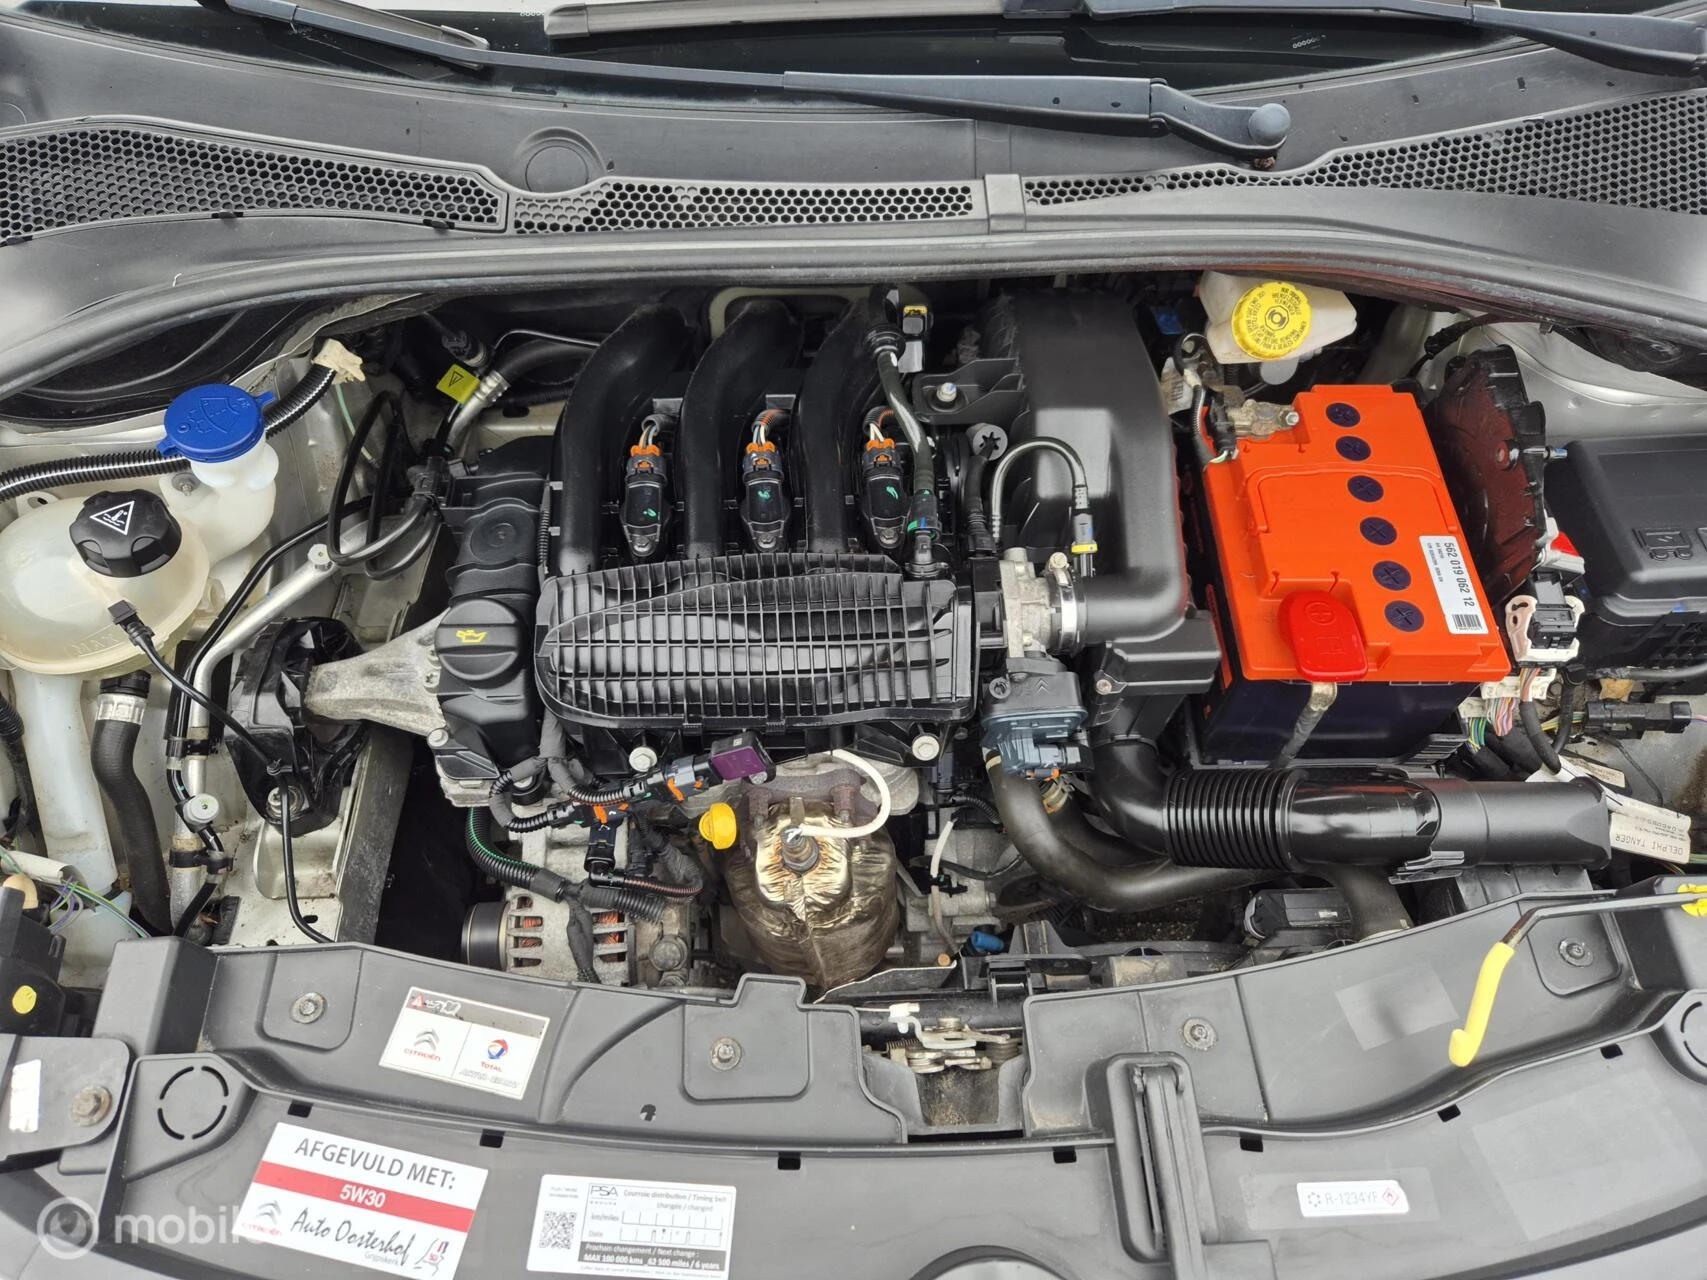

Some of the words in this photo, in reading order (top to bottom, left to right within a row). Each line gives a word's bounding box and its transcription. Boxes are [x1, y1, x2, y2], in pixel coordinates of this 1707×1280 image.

[1444, 542, 1458, 558] 562
[1450, 560, 1464, 576] 019
[1456, 577, 1470, 594] 062
[1463, 597, 1475, 607] 12
[1615, 833, 1646, 848] TANGER
[1652, 841, 1684, 856] DELPHI
[481, 1060, 503, 1073] TOTAL
[294, 1138, 404, 1177] AFGEVULD
[406, 1162, 456, 1190] MET:
[339, 1183, 386, 1208] 5W30
[590, 1185, 619, 1197] PSA
[651, 1191, 687, 1201] distribution
[1324, 1190, 1378, 1206] R-1234YF
[290, 1206, 332, 1238] Auto
[334, 1219, 417, 1267] Oosterhof
